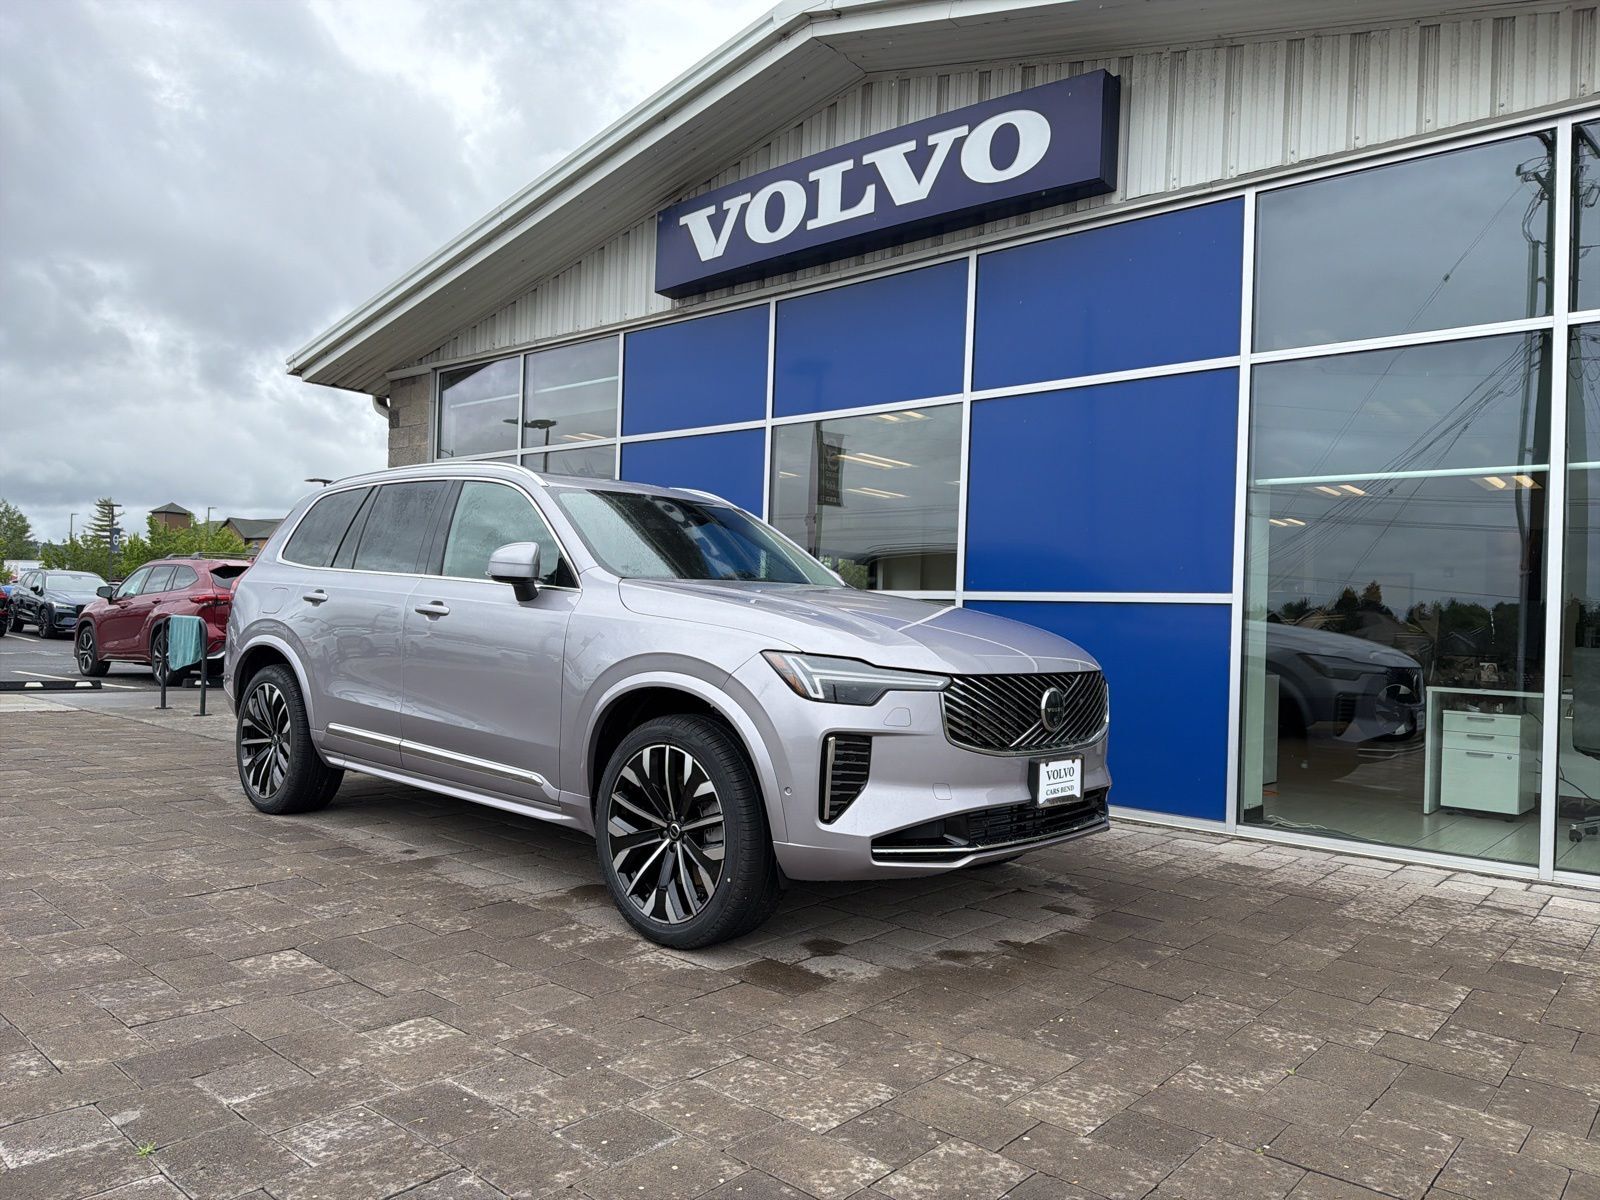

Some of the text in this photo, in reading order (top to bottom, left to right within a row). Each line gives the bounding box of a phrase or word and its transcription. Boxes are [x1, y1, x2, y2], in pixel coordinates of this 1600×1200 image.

[679, 109, 1052, 262] VOLVO
[1046, 766, 1075, 781] VOLVO
[1045, 784, 1075, 796] CARS BEND
